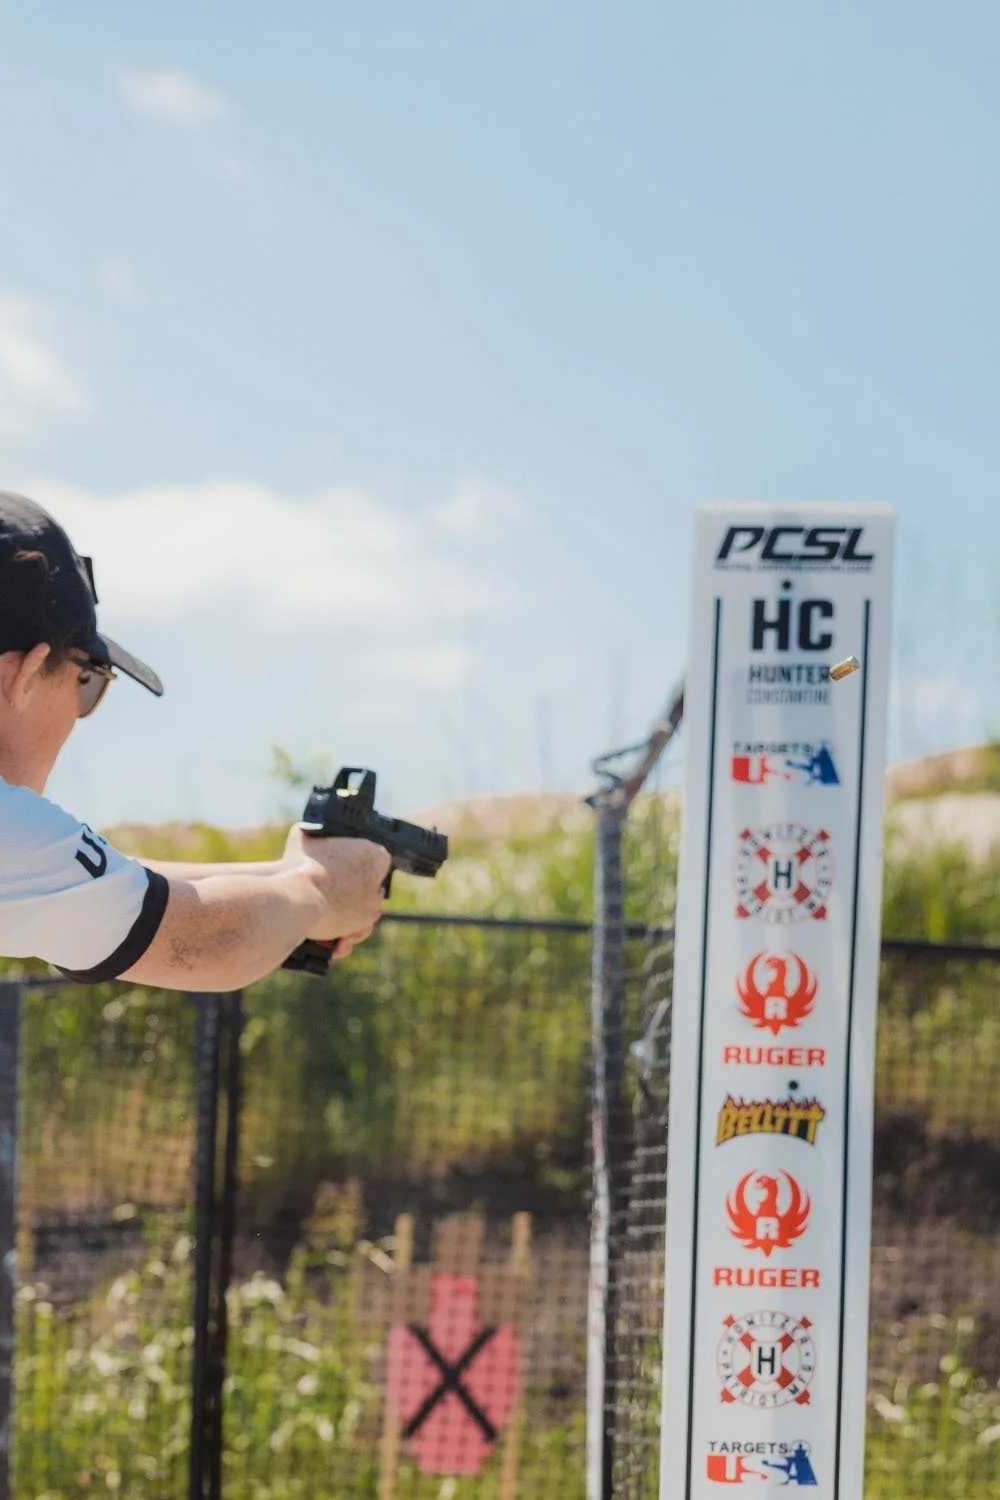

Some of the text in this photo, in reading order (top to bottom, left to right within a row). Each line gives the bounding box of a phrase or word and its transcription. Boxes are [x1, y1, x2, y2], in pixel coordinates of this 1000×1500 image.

[716, 526, 875, 560] PCSL
[752, 599, 834, 652] HC
[748, 664, 831, 684] HUNTER
[722, 1045, 827, 1066] RUGER
[713, 1267, 821, 1288] RUGER
[757, 1345, 777, 1376] H
[708, 1441, 790, 1454] TARGETS
